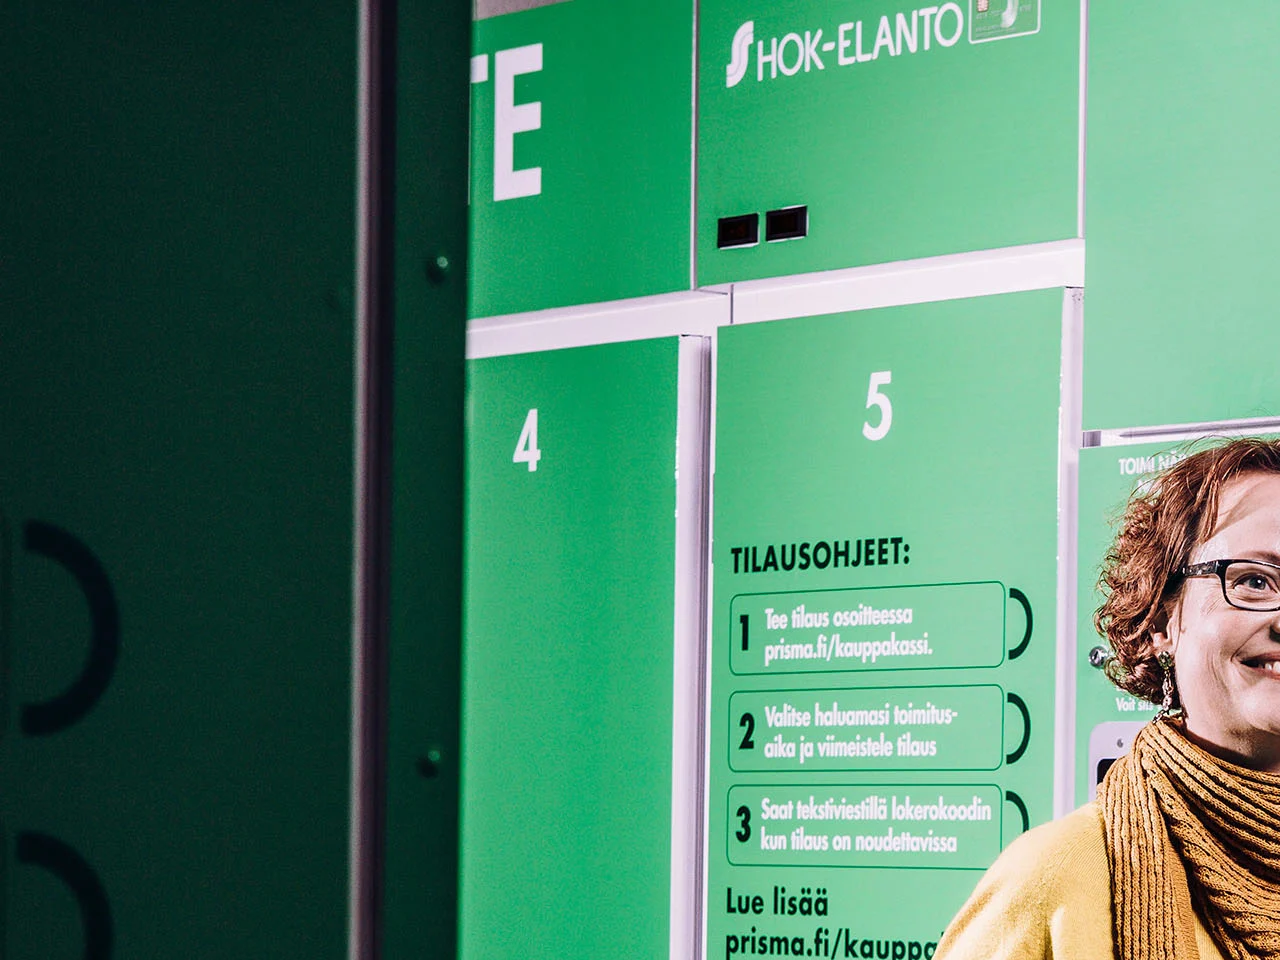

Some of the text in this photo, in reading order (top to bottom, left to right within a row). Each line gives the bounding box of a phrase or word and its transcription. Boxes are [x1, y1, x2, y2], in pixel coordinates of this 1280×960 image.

[757, 2, 965, 82] HOK-ELANTO
[470, 42, 543, 202] E
[862, 371, 893, 441] 5
[512, 408, 541, 472] 4
[731, 537, 910, 573] TILAUSOHJEET:
[740, 614, 749, 651] 1
[765, 603, 913, 629] Tee tilaus osoitteessa
[764, 631, 933, 667] prisma.fi/kauppakassi.
[738, 712, 755, 749] 2
[765, 701, 958, 728] Valitse haluamasi toimitus-
[764, 731, 937, 763] aika ja viimeistele tilaus
[735, 805, 751, 843] 3
[760, 795, 991, 822] Saat tekstiviestillä lokerokoodin
[760, 826, 957, 853] kun tilaus on noudettavissa
[726, 885, 829, 917] Lue lisää
